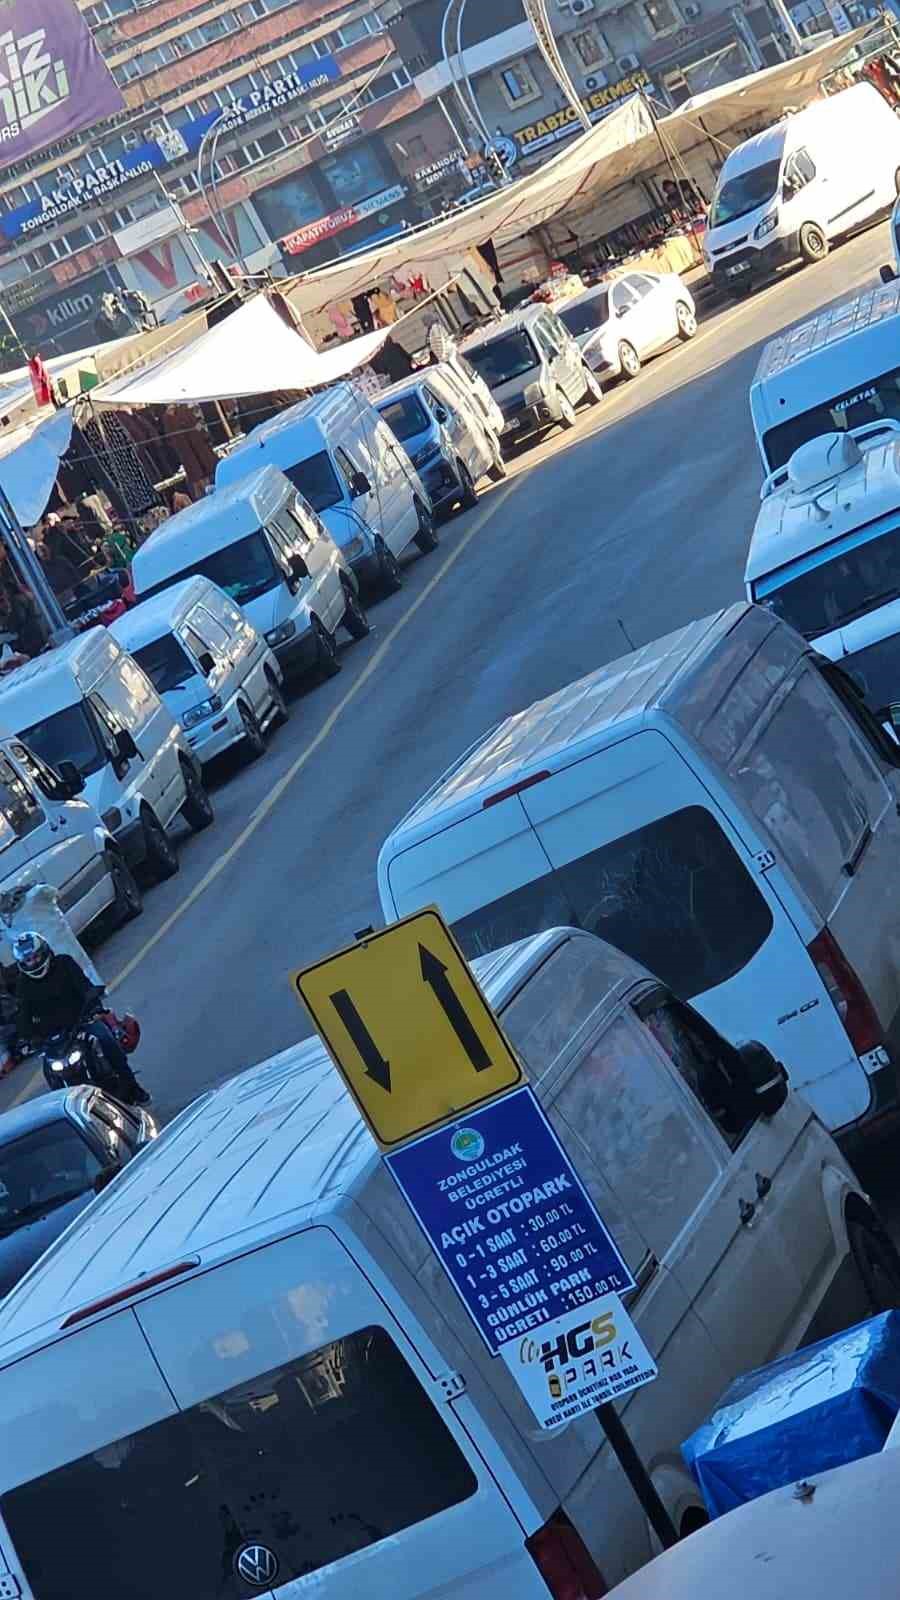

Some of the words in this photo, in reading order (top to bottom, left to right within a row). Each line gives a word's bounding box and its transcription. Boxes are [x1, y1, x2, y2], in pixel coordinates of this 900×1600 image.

[20, 195, 82, 233] ZONGULDAK
[40, 190, 69, 211] AK
[437, 1142, 523, 1191] ZONGULDAK
[440, 1216, 486, 1249] AÇIK
[486, 1173, 573, 1224] OTOPARK
[464, 1175, 524, 1210] ÜCRETLİ
[486, 1228, 517, 1252] SAAT
[560, 1202, 574, 1216] TL
[497, 1248, 528, 1273] SAAT
[572, 1223, 586, 1236] TL
[508, 1268, 540, 1293] SAAT
[584, 1242, 597, 1255] TL
[609, 1274, 621, 1286] TL
[487, 1288, 549, 1327] GÜNLÜK
[550, 1267, 593, 1296] PARK
[540, 1311, 617, 1373] HGS
[564, 1342, 632, 1389] PARK
